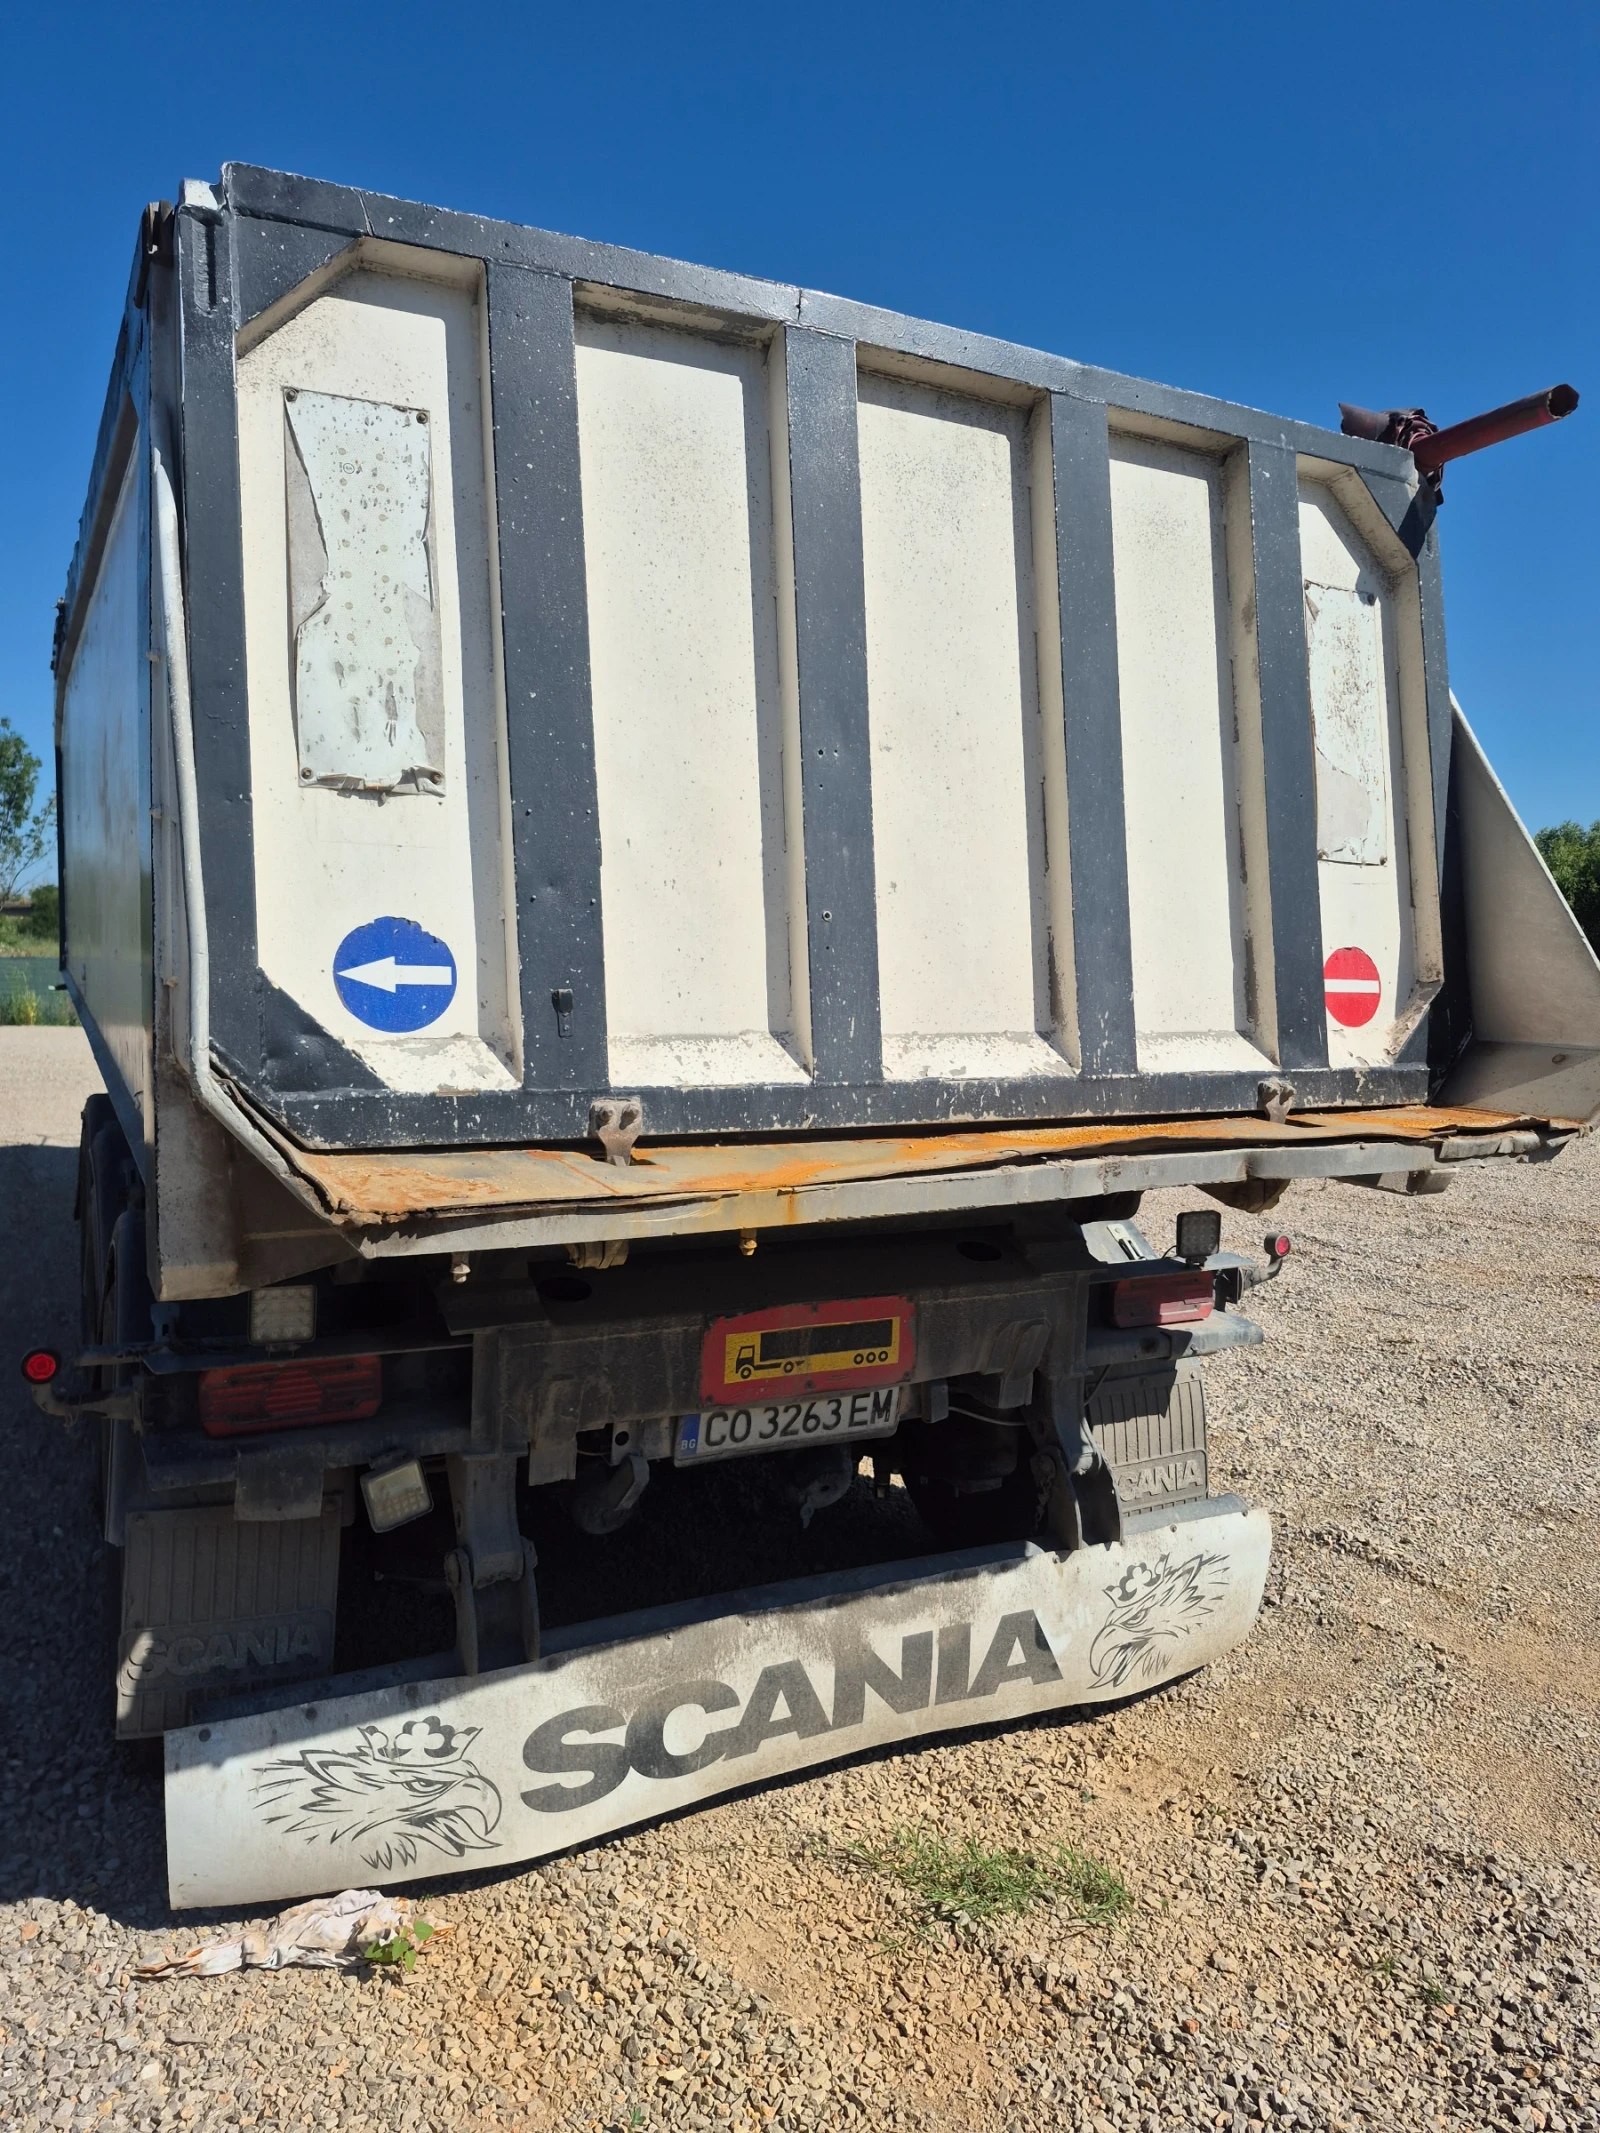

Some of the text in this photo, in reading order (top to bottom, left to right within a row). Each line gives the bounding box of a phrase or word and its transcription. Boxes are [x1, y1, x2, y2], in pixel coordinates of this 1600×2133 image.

[681, 1438, 696, 1450] BG
[704, 1389, 894, 1447] CO 3263 EM
[1118, 1459, 1203, 1502] CANIA
[127, 1625, 323, 1681] SCANIA
[519, 1608, 1064, 1813] SCANIA
